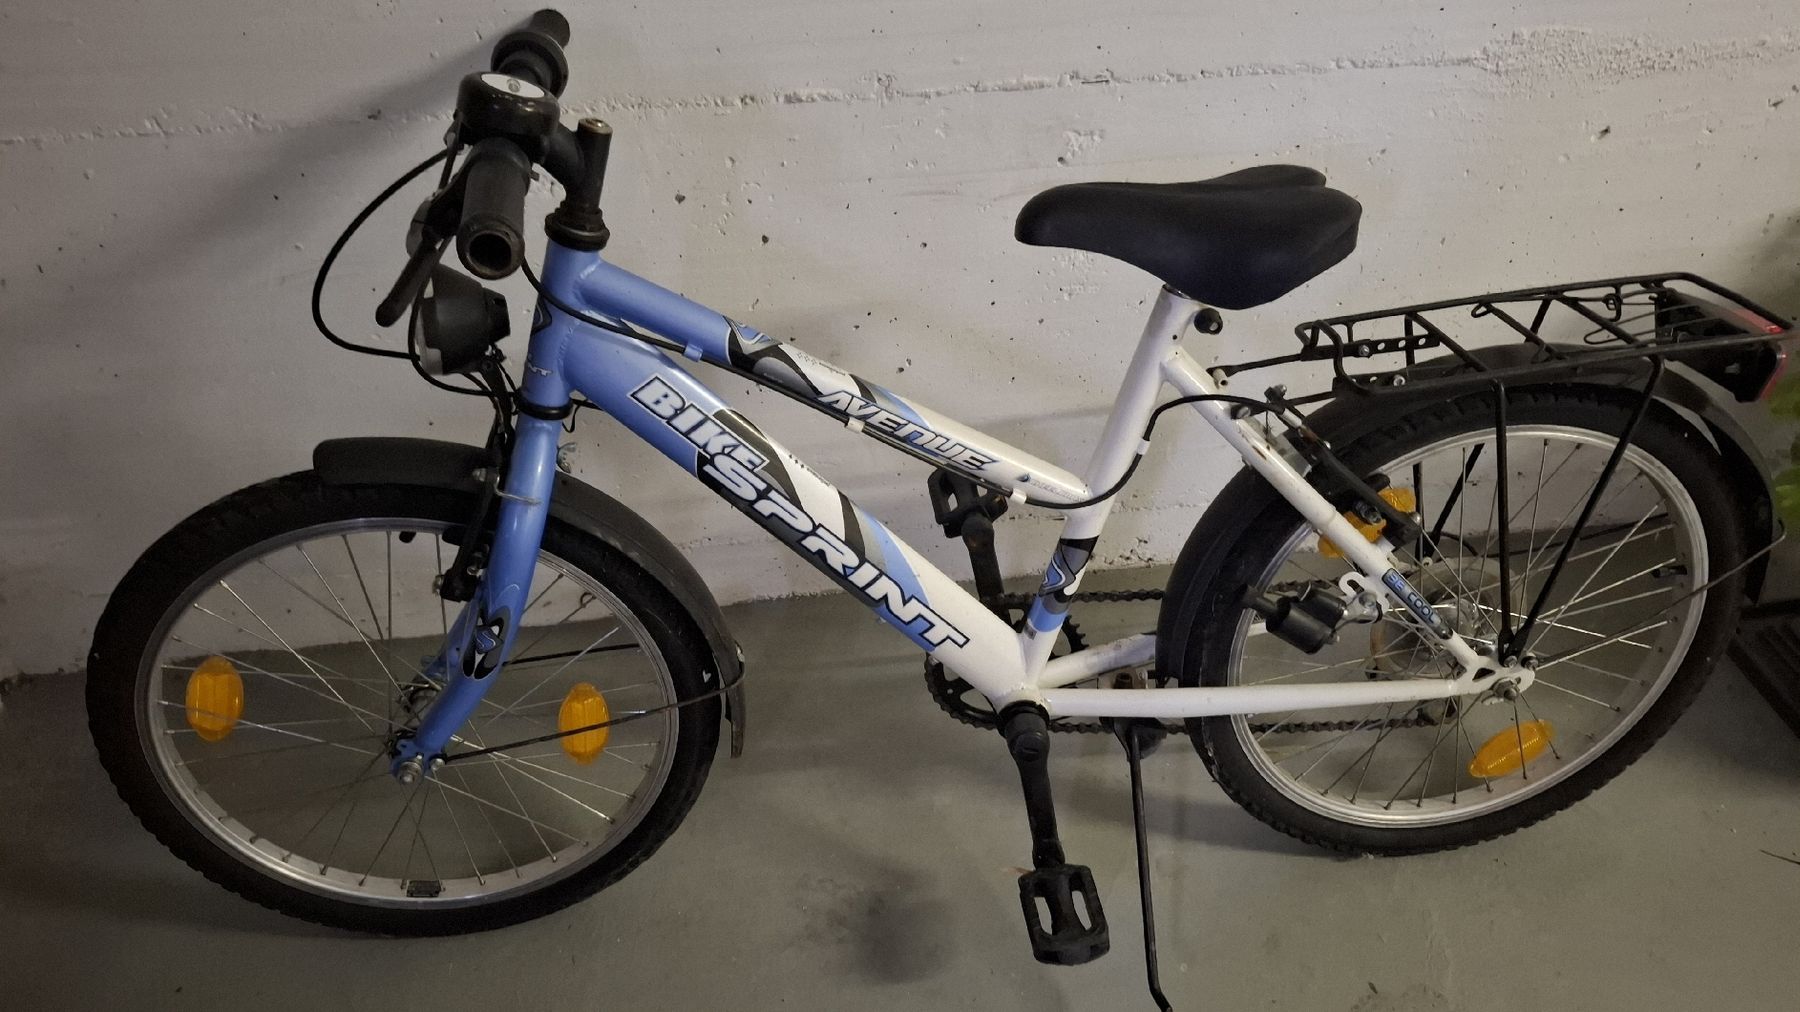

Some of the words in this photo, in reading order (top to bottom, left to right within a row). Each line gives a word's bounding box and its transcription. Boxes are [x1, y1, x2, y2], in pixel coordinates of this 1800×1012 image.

[630, 376, 769, 473] BIKE
[817, 390, 999, 471] AVENUE
[702, 453, 970, 649] SPRINT
[1408, 592, 1435, 624] COOL
